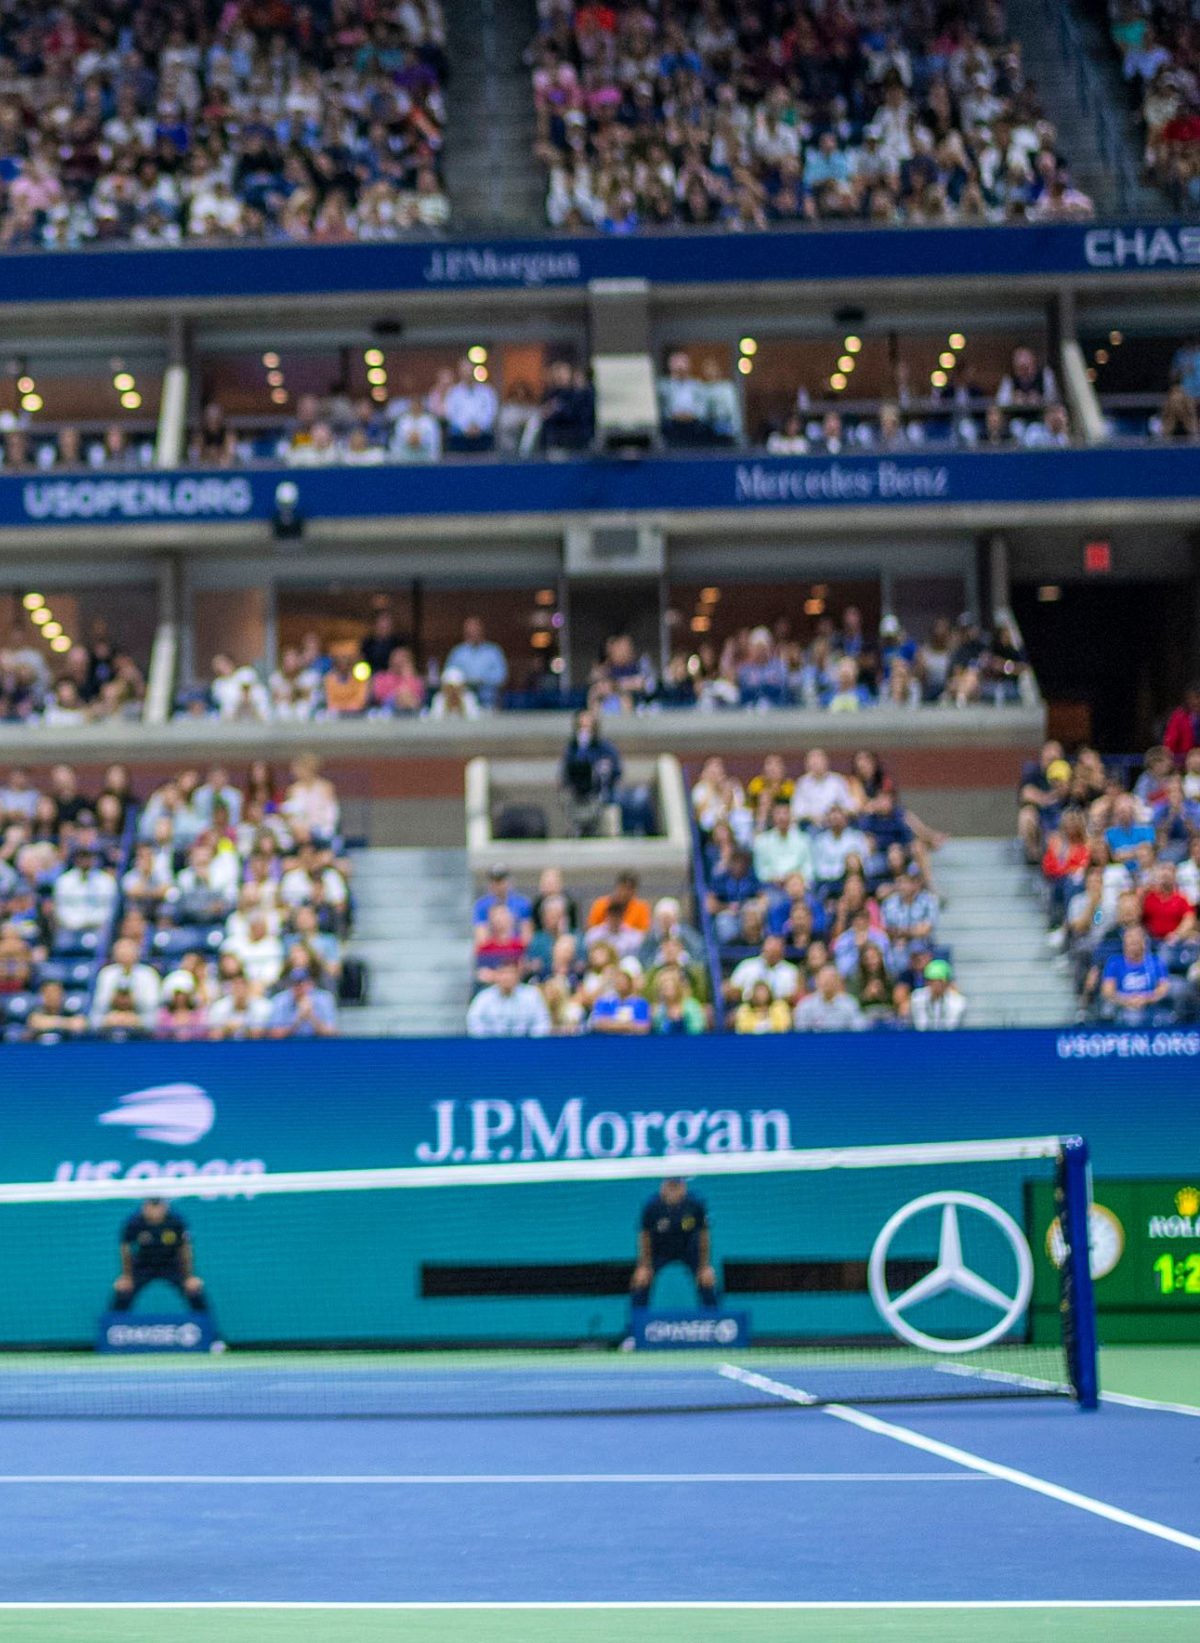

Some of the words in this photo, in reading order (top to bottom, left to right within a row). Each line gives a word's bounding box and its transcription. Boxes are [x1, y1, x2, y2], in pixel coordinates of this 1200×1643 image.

[1085, 227, 1200, 267] CHAS
[23, 477, 251, 517] USOPEN.ORG
[415, 1098, 793, 1163] J.P.Morgan
[1149, 1214, 1200, 1239] ROL
[1153, 1253, 1200, 1295] 1:2
